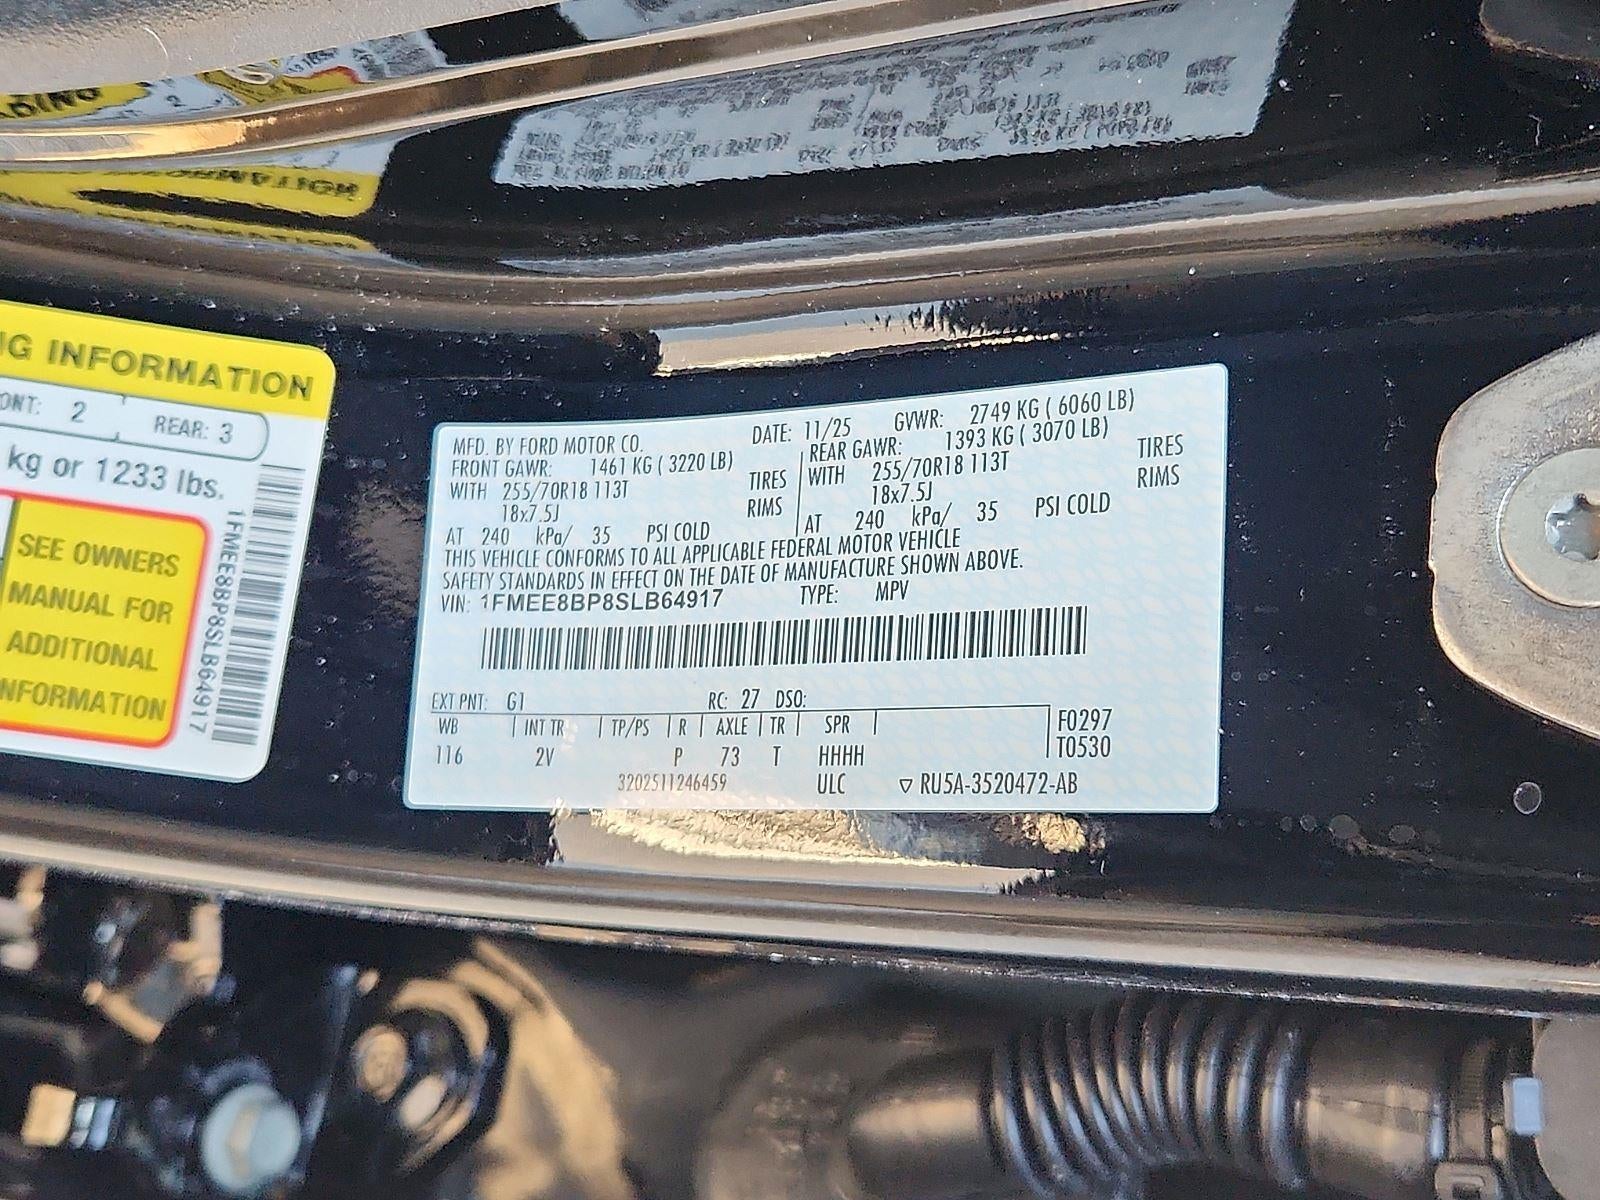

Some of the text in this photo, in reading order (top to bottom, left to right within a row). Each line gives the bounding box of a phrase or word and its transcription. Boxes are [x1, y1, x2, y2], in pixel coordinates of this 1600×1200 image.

[48, 340, 313, 400] INFORMATION
[895, 409, 943, 432] GVWR:
[970, 401, 1010, 425] 2749
[1018, 398, 1039, 420] KG
[1059, 392, 1100, 416] 6060
[1108, 388, 1134, 412] LB)
[71, 401, 87, 422] 2
[154, 415, 208, 440] REAR:
[220, 423, 234, 443] 3
[752, 417, 851, 444] DATE: 11/25
[453, 434, 643, 456] MFD. BY FORD MOTOR CO.
[810, 441, 846, 462] REAR
[853, 437, 902, 458] GAWR:
[946, 428, 985, 450] 1393
[992, 425, 1014, 447] KG
[1032, 419, 1075, 442] 3070
[1082, 416, 1108, 439] LB)
[1137, 434, 1183, 458] TIRES
[8, 444, 224, 500] kg or 1233 lbs.
[452, 459, 500, 478] FRONT
[505, 459, 552, 478] GAWR:
[592, 457, 625, 476] 1461
[633, 456, 652, 475] KG
[669, 453, 705, 472] 3220
[710, 450, 732, 472] LB)
[808, 450, 1010, 486] WITH 255/70R18 113T
[749, 469, 786, 490] TIRES
[1138, 464, 1179, 488] RIMS
[450, 480, 629, 503] WITH 255/70R18 113T
[872, 481, 932, 505] 18x7.5J
[503, 504, 559, 522] 18x7.5J
[748, 496, 782, 518] RIMS
[804, 492, 1110, 534] AT 240 kPa/ 35 PSI COLD
[446, 522, 710, 548] AT 240 kPa/ 35 PSI COLD
[18, 534, 180, 577] SEE OWNERS
[445, 528, 960, 568] THIS VEHICLE CONFORMS TO ALL APPLICABLE FEDERAL MOTOR VEHICLE
[443, 548, 1023, 590] SAFETY STANDARDS IN EFFECT ON THE DATE OF MANUFACTURE SHOWN ABOVE.
[8, 580, 174, 624] MANUAL FOR
[442, 588, 723, 612] VIN: 1FMEE8BP8SLB64917
[800, 580, 909, 605] TYPE: MPV
[189, 510, 246, 734] 1FMEE8BP8SLB64917
[6, 630, 158, 672] ADDITIONAL
[432, 692, 524, 711] EXT PNT: G1
[708, 688, 806, 710] RC: 27 DSO:
[439, 717, 458, 734] WB
[525, 719, 564, 736] INT TR
[612, 716, 649, 738] TP/PS
[679, 718, 686, 736] R
[716, 717, 748, 736] AXLE
[770, 716, 786, 734] TR
[825, 715, 850, 734] SPR
[1058, 708, 1112, 734] F0297
[437, 745, 462, 765] 116
[536, 747, 554, 766] 2V
[674, 747, 682, 767] P
[721, 746, 740, 767] 73
[773, 746, 781, 766] T
[819, 744, 864, 766] HHHH
[1056, 735, 1110, 758] T0530
[618, 774, 726, 791] 3202511246459
[818, 772, 846, 794] ULC
[921, 772, 1077, 794] RU5A-3520472-AB
